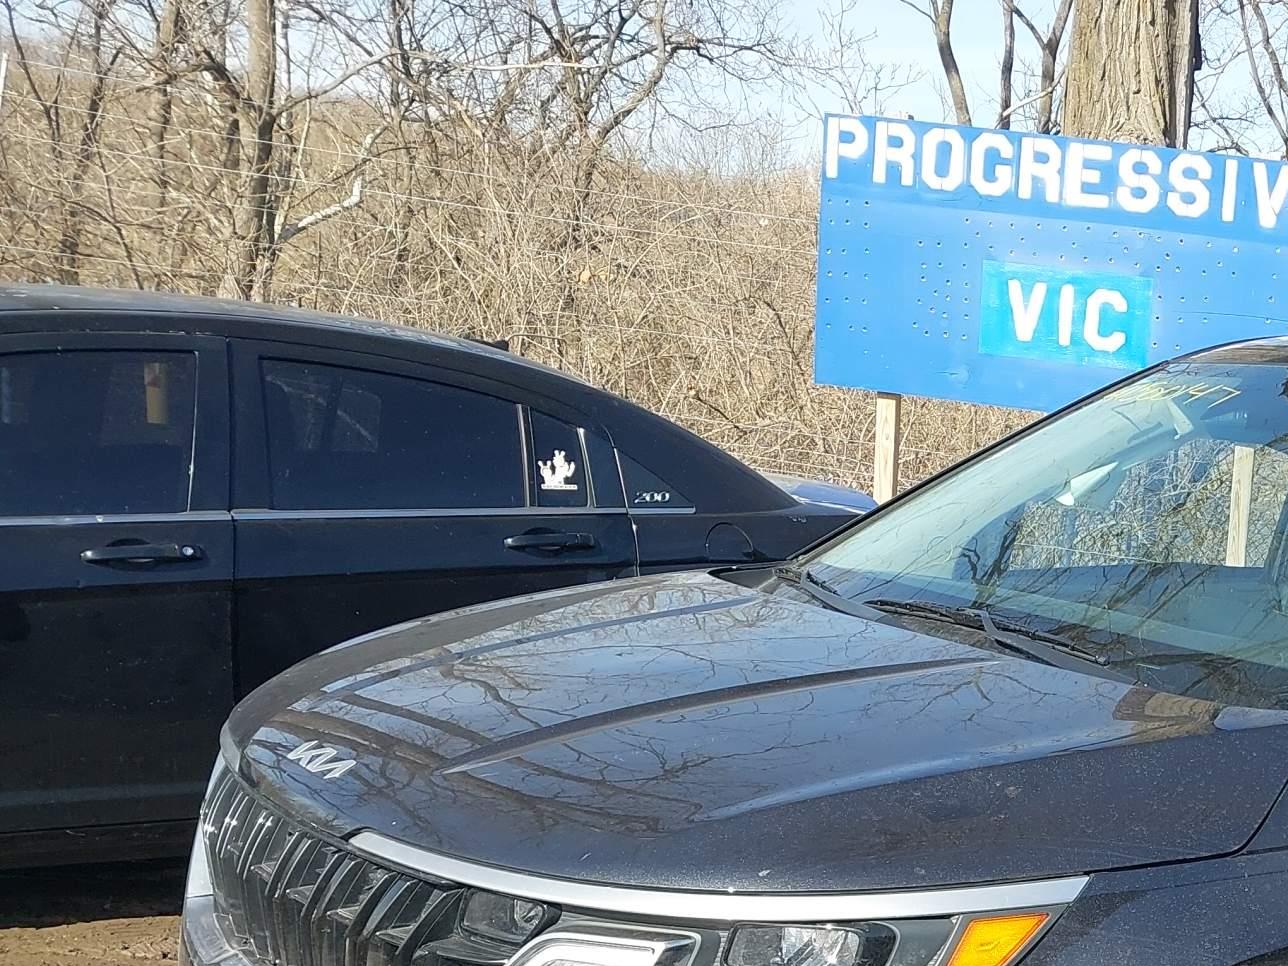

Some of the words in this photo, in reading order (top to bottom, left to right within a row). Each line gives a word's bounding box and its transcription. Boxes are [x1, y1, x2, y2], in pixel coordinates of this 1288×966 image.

[1007, 277, 1129, 353] VIC
[633, 491, 670, 504] 200
[286, 740, 357, 780] KIA
